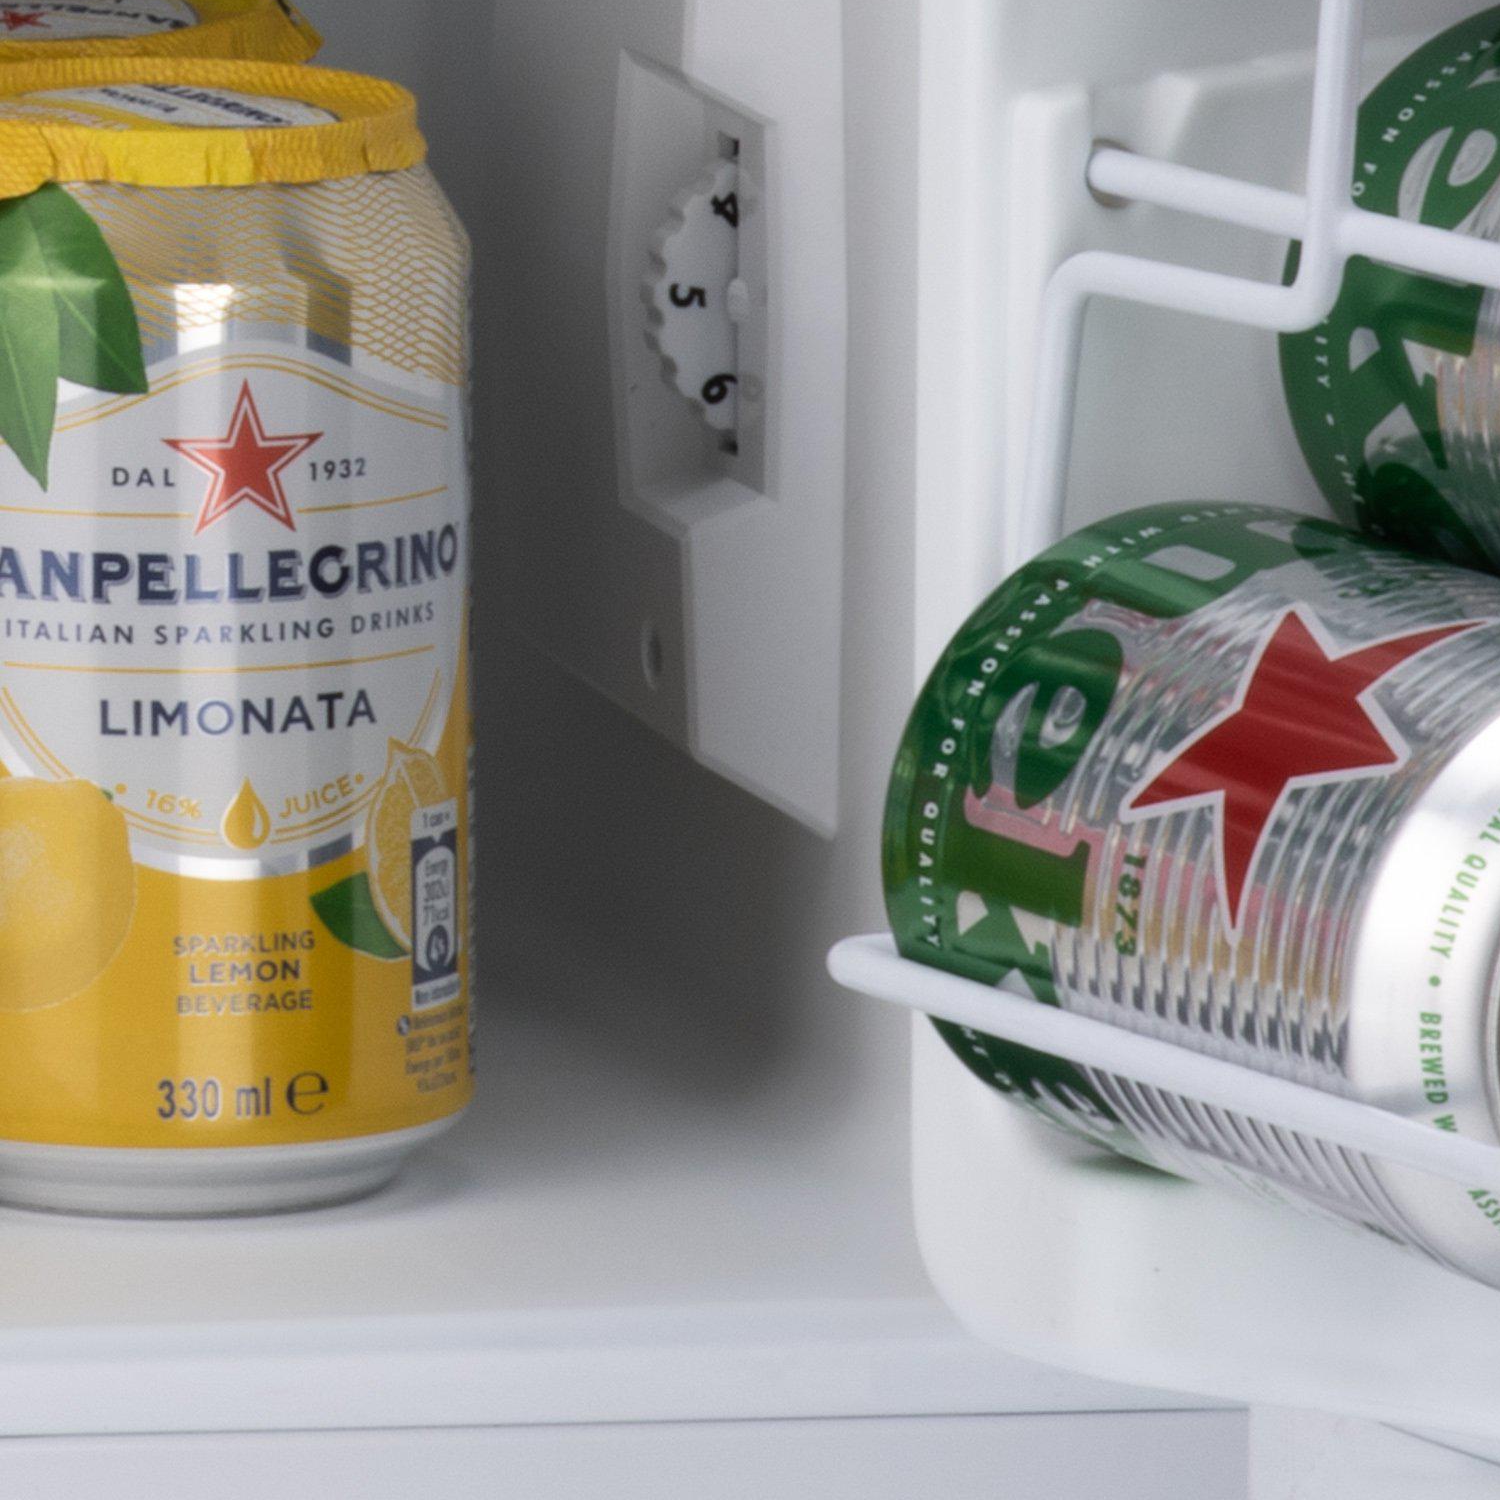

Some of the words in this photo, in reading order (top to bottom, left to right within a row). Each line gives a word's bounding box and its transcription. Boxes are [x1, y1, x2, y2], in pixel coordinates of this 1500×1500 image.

[711, 191, 739, 229] 4
[669, 282, 706, 309] 5
[111, 467, 176, 488] DAL
[308, 457, 367, 482] 1932
[6, 618, 135, 646] ITALIAN
[155, 617, 336, 646] SPARKLING
[350, 601, 435, 636] DRINKS
[965, 577, 1071, 698] PASSION
[99, 689, 377, 737] LIMONATA
[931, 715, 966, 780] FOR
[145, 788, 201, 820] 16%
[278, 774, 353, 820] JUICE
[917, 800, 940, 948] QUALITY
[1115, 852, 1147, 957] 1873
[1429, 853, 1488, 959] QUALITY
[173, 929, 316, 957] SPARKLING
[189, 958, 302, 986] LEMON
[177, 989, 314, 1016] BEVERAGE
[1419, 1011, 1450, 1105] BREWED
[157, 1078, 222, 1120] 330
[235, 1076, 272, 1118] ml
